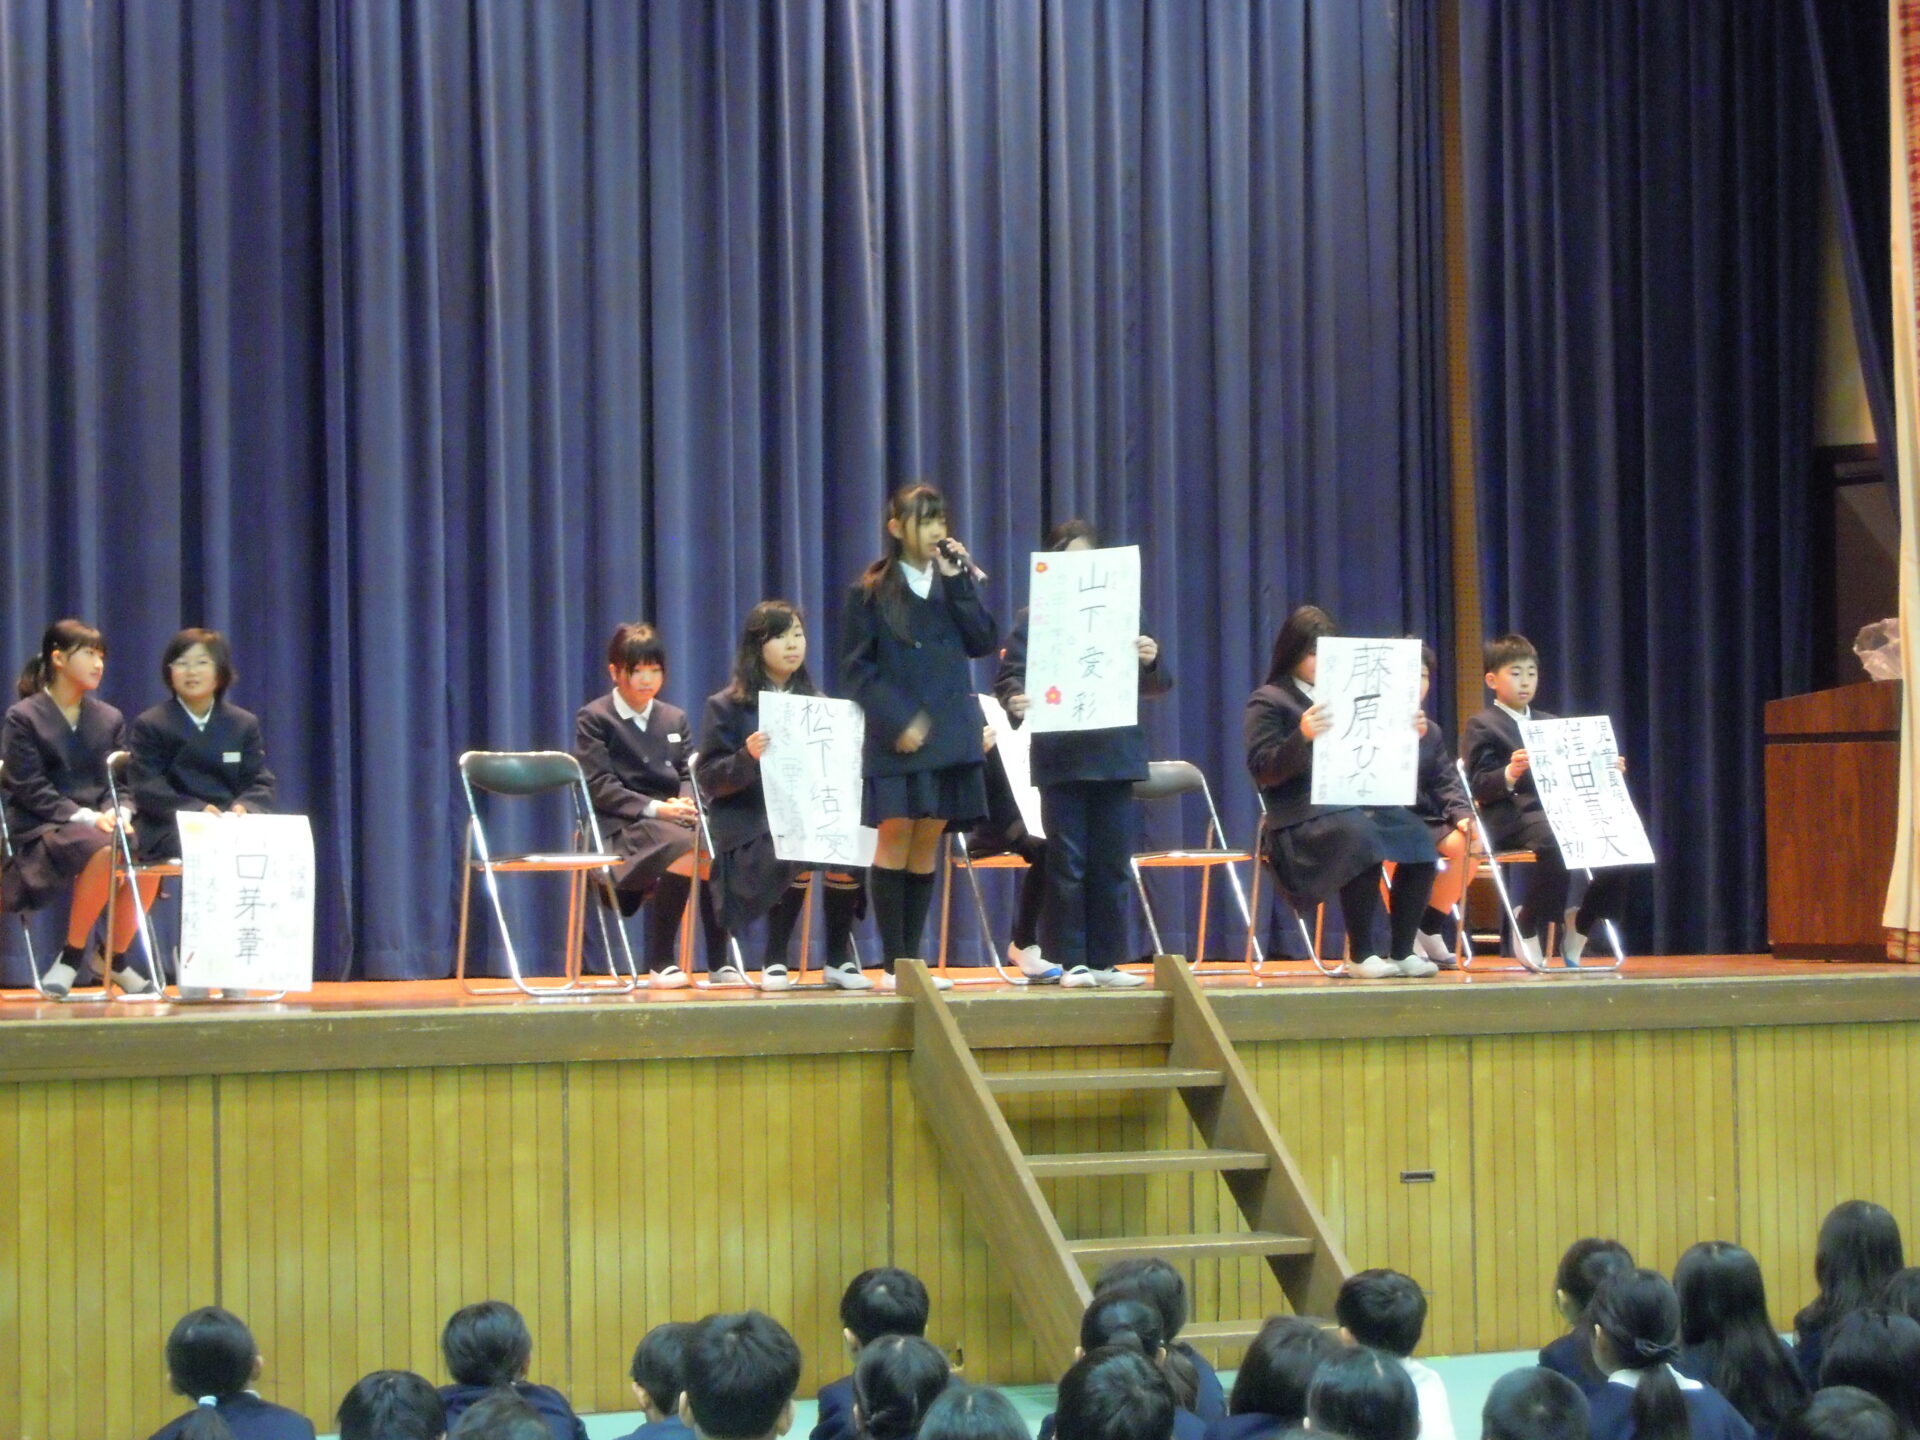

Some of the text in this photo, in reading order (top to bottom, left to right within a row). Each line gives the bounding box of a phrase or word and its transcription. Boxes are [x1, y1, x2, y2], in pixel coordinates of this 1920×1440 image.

[1072, 561, 1109, 723] 山下愛彩
[1341, 643, 1395, 798] 藤原ひな
